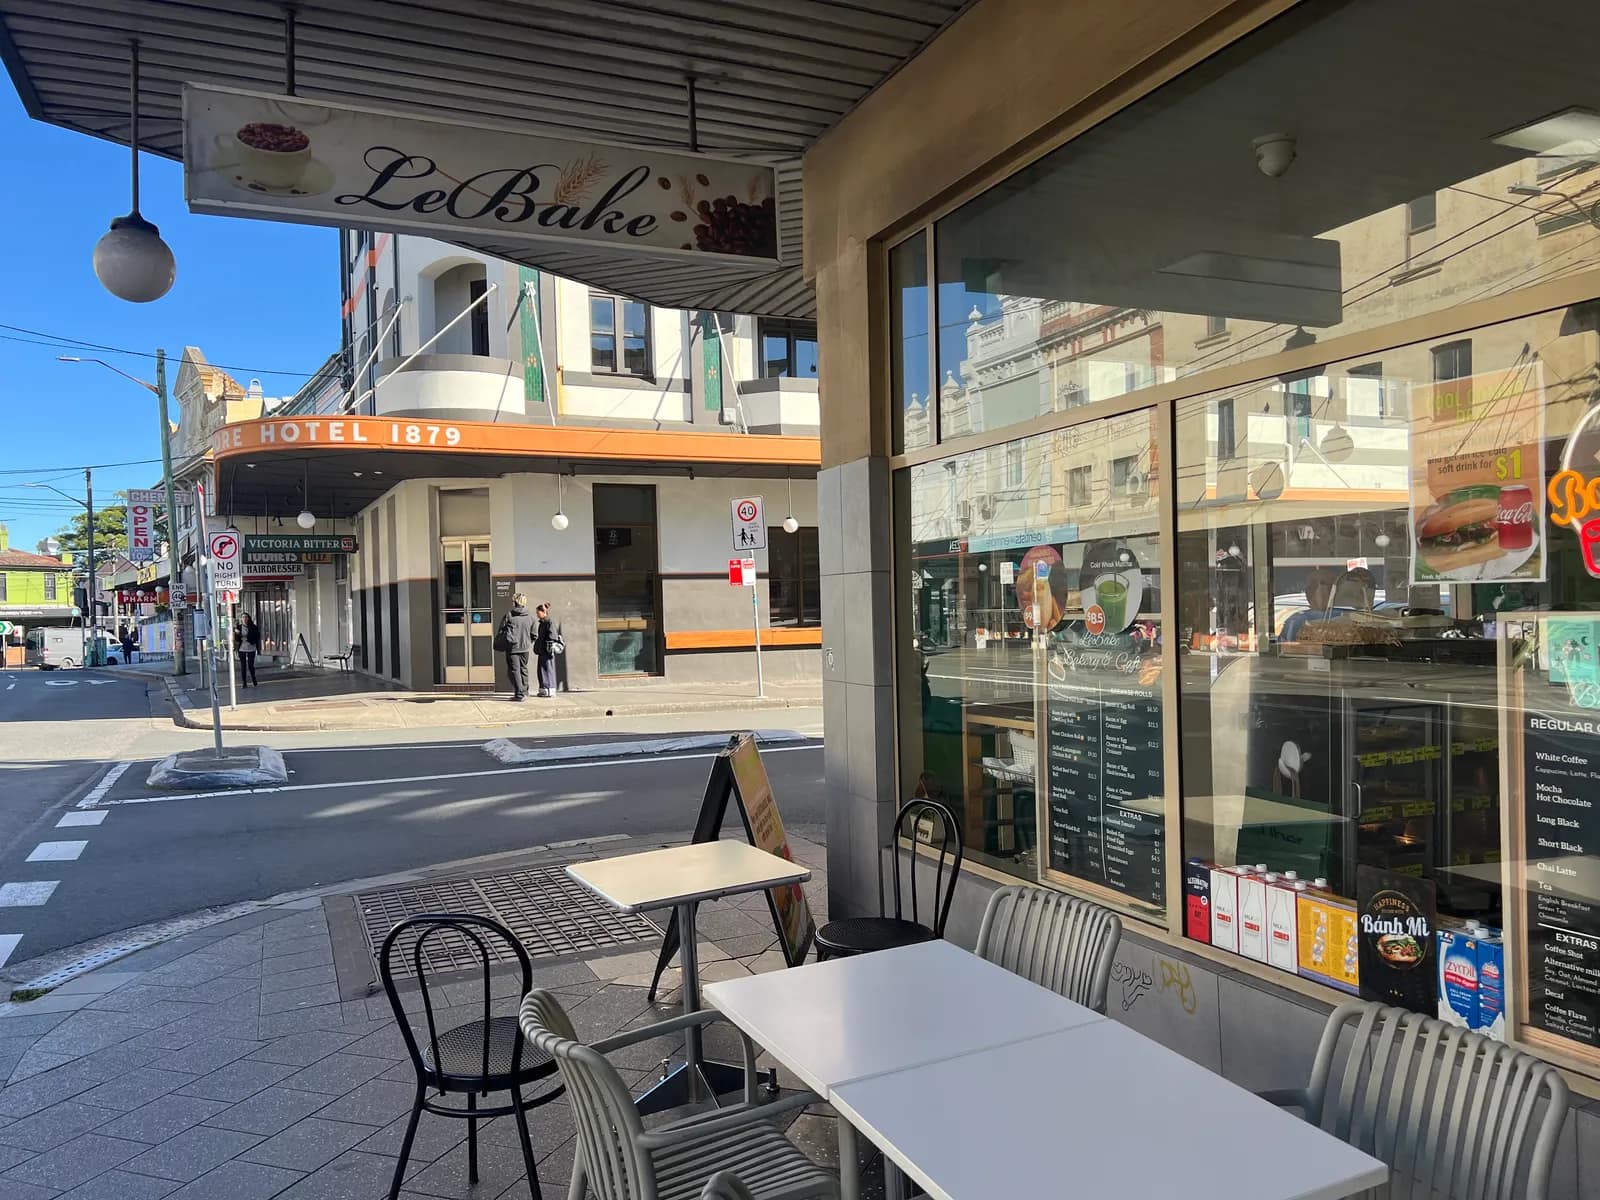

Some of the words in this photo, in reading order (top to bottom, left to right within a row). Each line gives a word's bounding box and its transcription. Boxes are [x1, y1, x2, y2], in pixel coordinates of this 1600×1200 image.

[260, 422, 368, 443] HOTEL
[391, 424, 461, 445] 1879
[1438, 464, 1454, 474] soft
[1455, 461, 1478, 472] drink
[1480, 459, 1493, 469] for
[1496, 449, 1521, 480] $1
[741, 506, 754, 516] 40
[132, 505, 149, 547] OPEN
[248, 539, 300, 548] VICTORIA
[303, 540, 340, 548] BITTER
[217, 562, 233, 571] NO
[246, 564, 302, 573] HAIRDRESSER
[1530, 718, 1593, 733] REGULAR
[1535, 752, 1561, 762] White
[1561, 754, 1588, 765] Coffee
[1536, 783, 1562, 793] Mocha
[1536, 793, 1551, 802] Hot
[1552, 795, 1592, 808] Chocolate
[1119, 810, 1142, 822] EXTRAS
[1536, 814, 1556, 825] Long
[1557, 817, 1580, 828] Black
[1538, 837, 1559, 848] Short
[1560, 841, 1583, 853] Black
[1537, 862, 1555, 872] Chai
[1556, 865, 1577, 877] Latte
[1537, 880, 1552, 890] Tea
[1360, 913, 1404, 936] Bánh
[1406, 916, 1430, 937] Mì
[1555, 933, 1598, 950] EXTRAS
[1544, 943, 1567, 955] Coffee
[1567, 949, 1584, 959] Shot
[1544, 956, 1585, 973] Alternative
[1544, 1003, 1567, 1015] Coffee
